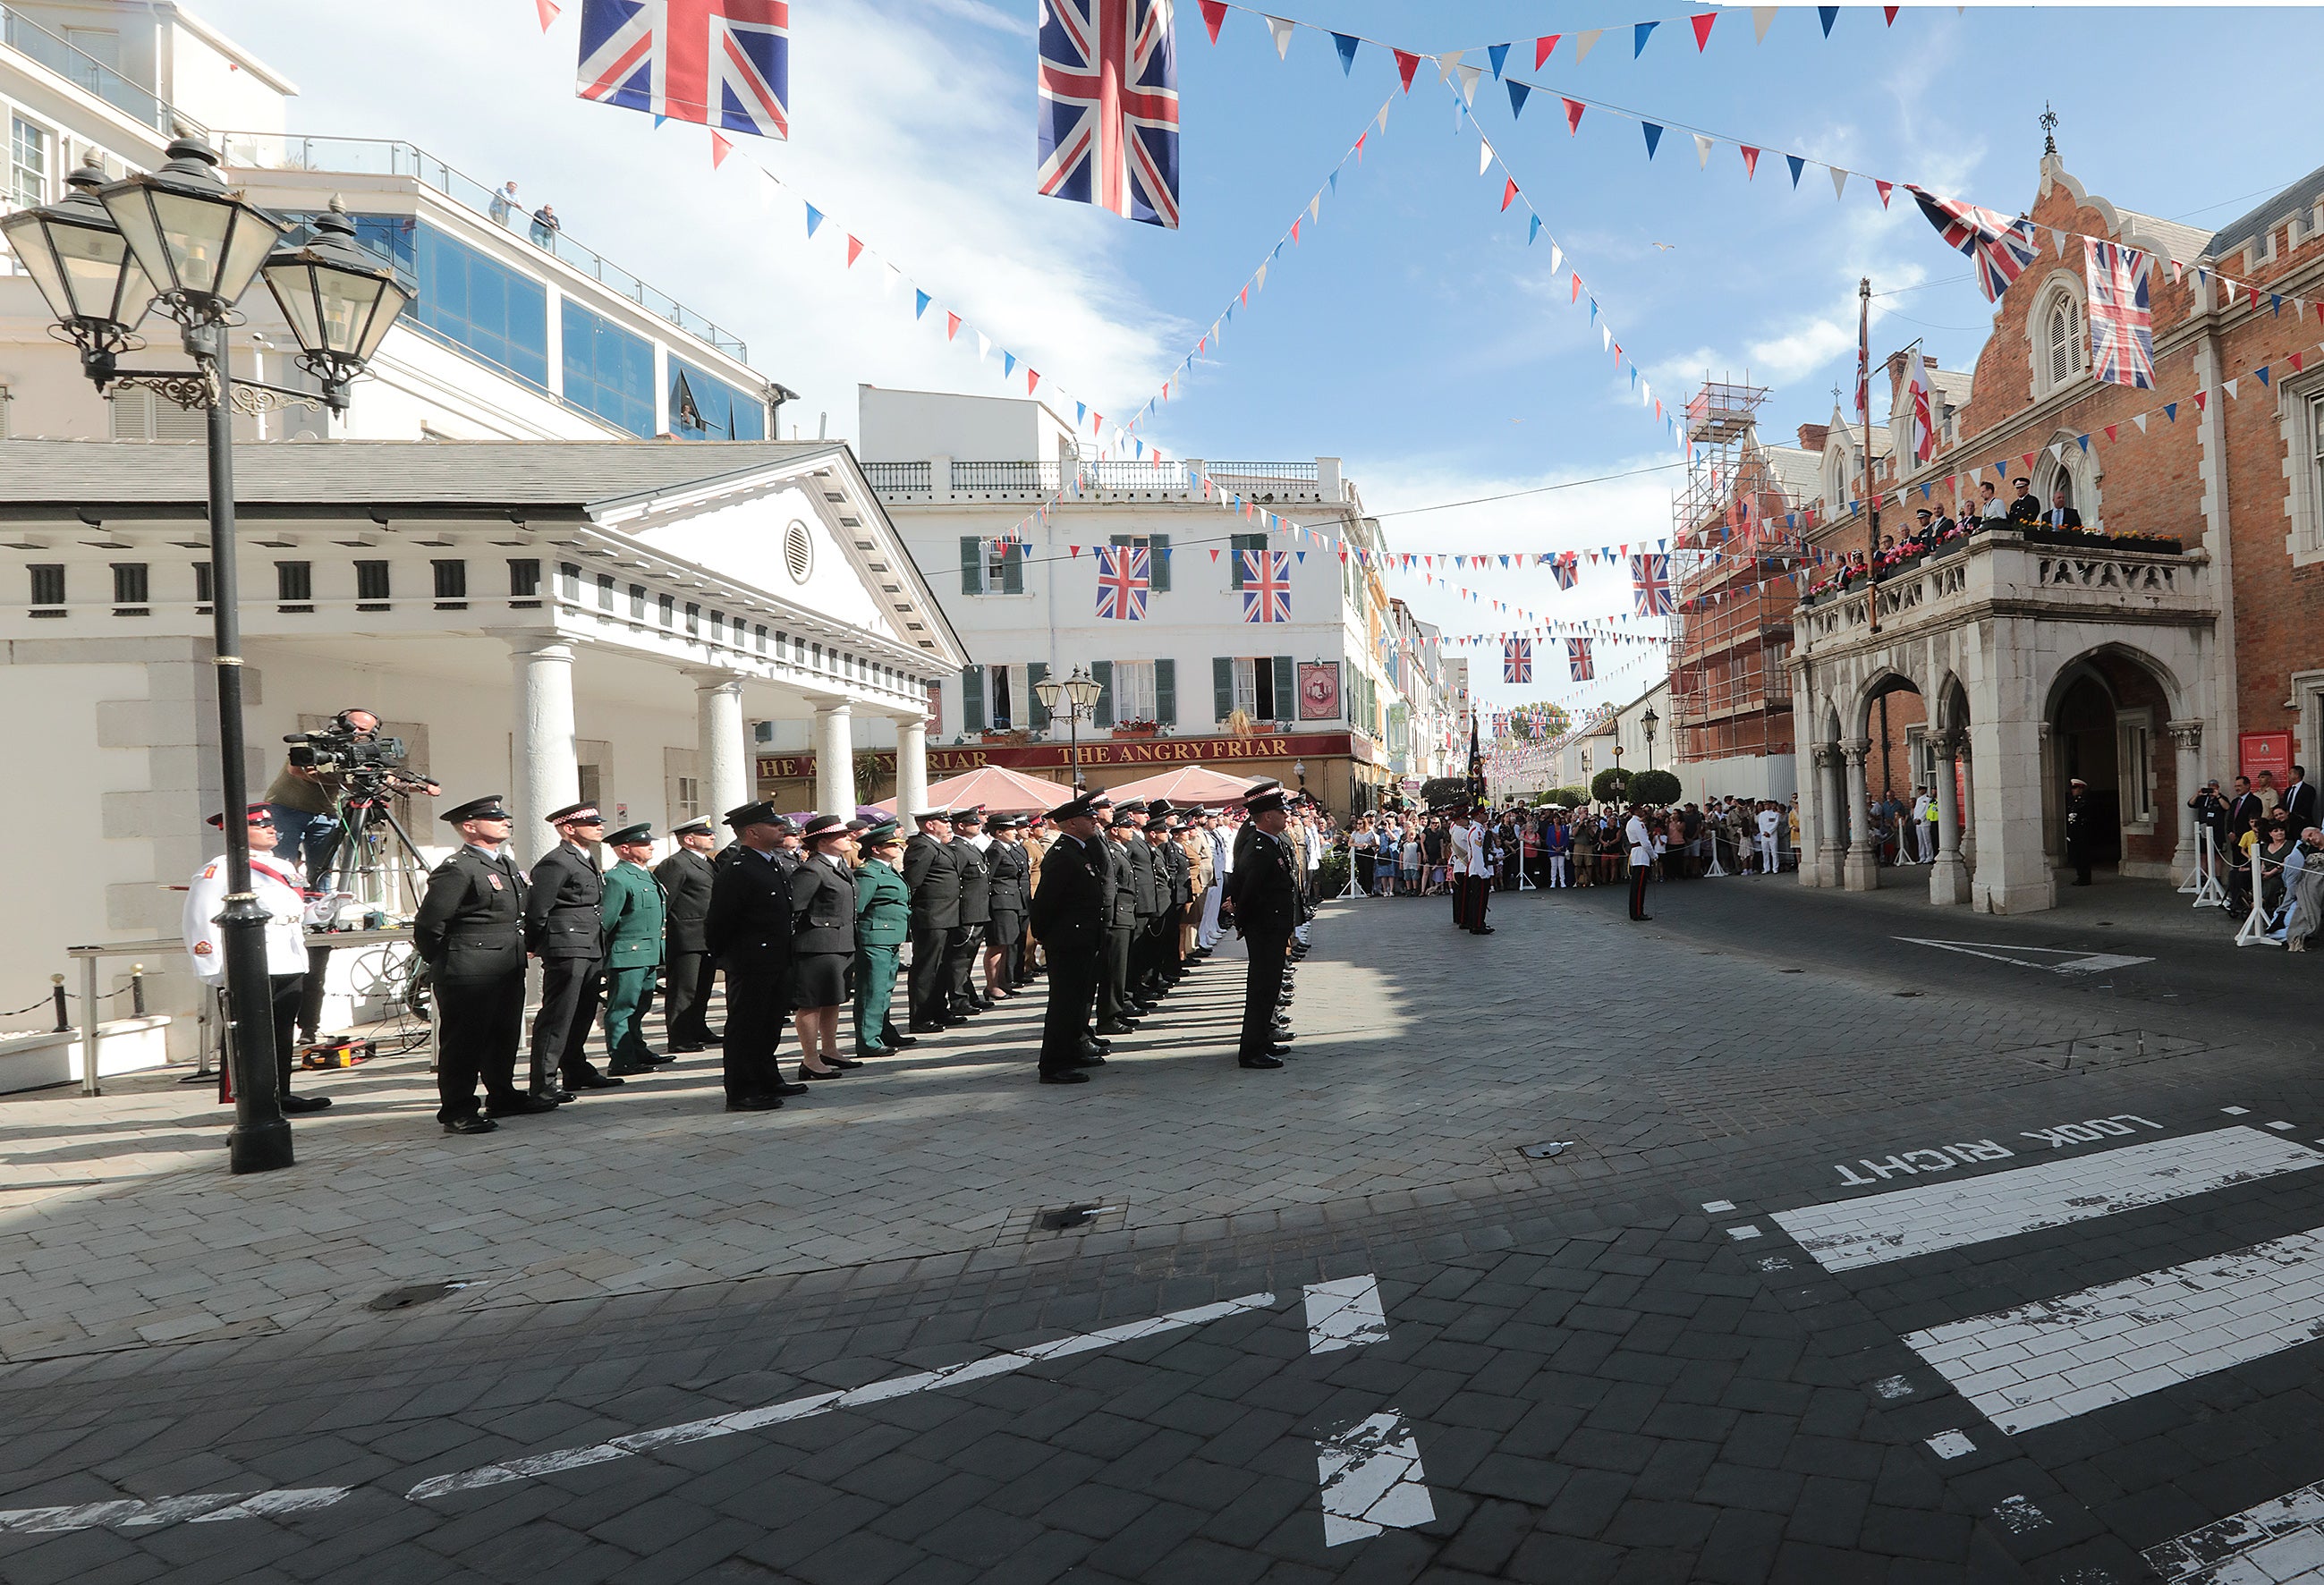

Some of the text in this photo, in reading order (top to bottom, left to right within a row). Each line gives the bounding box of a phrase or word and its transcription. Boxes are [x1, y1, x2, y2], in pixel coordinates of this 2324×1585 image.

[759, 759, 798, 777] HE
[926, 750, 988, 770] RIAR
[1058, 739, 1289, 764] THE ANGRY FRIAR
[1835, 1114, 2163, 1186] LOOK RIGHT
